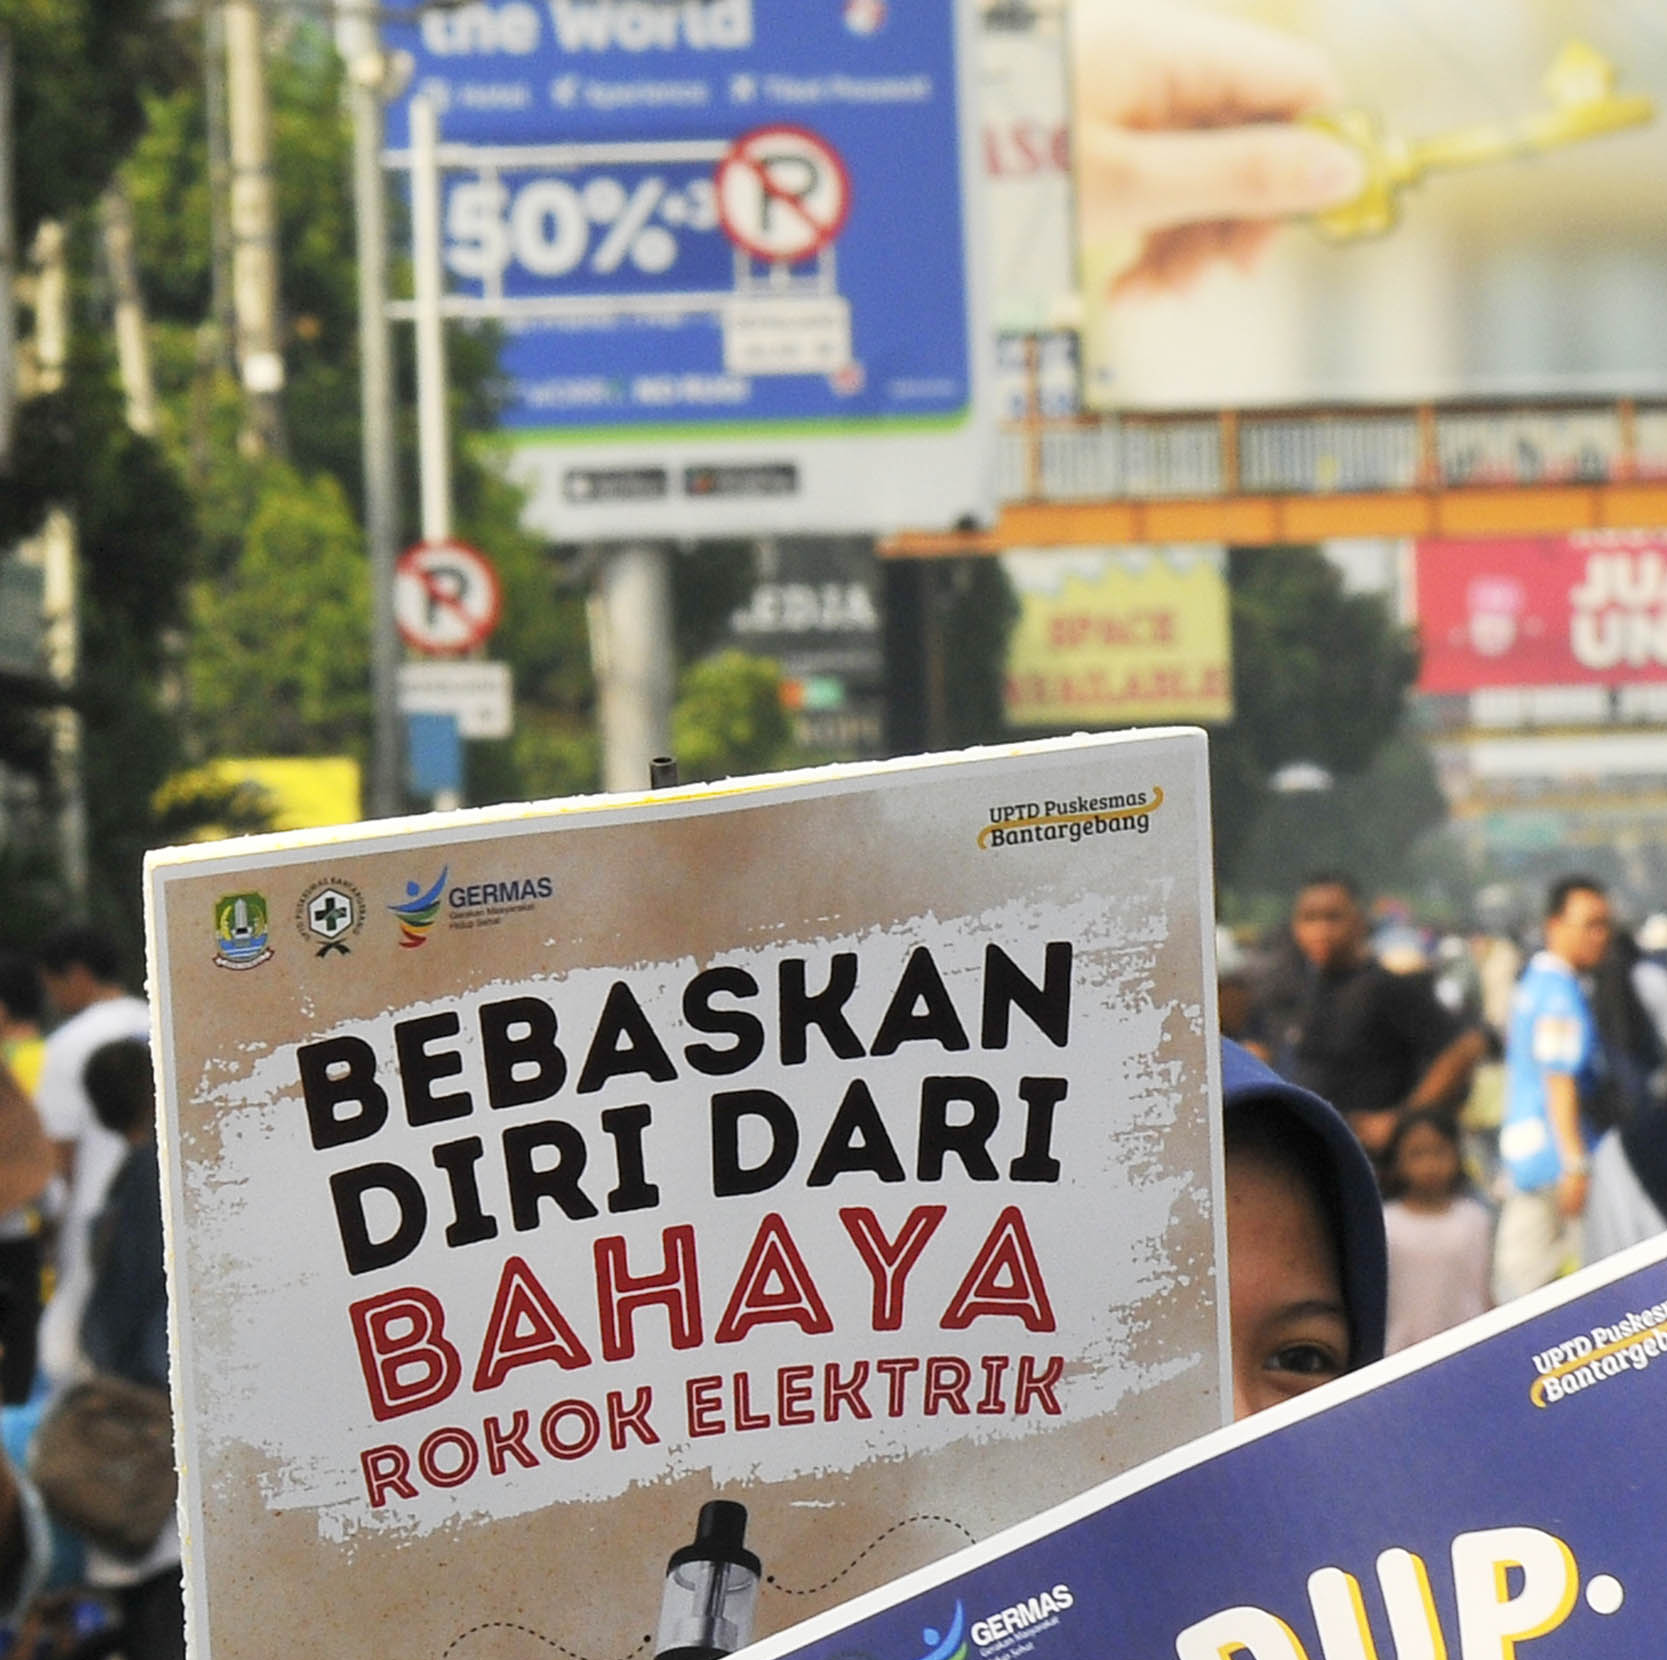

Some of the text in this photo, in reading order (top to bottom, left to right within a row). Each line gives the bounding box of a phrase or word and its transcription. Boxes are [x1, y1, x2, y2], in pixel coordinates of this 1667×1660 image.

[989, 791, 1147, 824] UPTD Puskesmas
[991, 812, 1150, 848] Bantargebang
[448, 876, 553, 908] GERMAS
[297, 940, 1074, 1151] BEBASKAN
[328, 1076, 1069, 1276] DIRI DARI
[348, 1205, 1057, 1423] BAHAYA
[1531, 1335, 1593, 1375] UPTD
[360, 1354, 1065, 1508] ROKOK ELEKTRIK
[970, 1583, 1074, 1647] GERMAS
